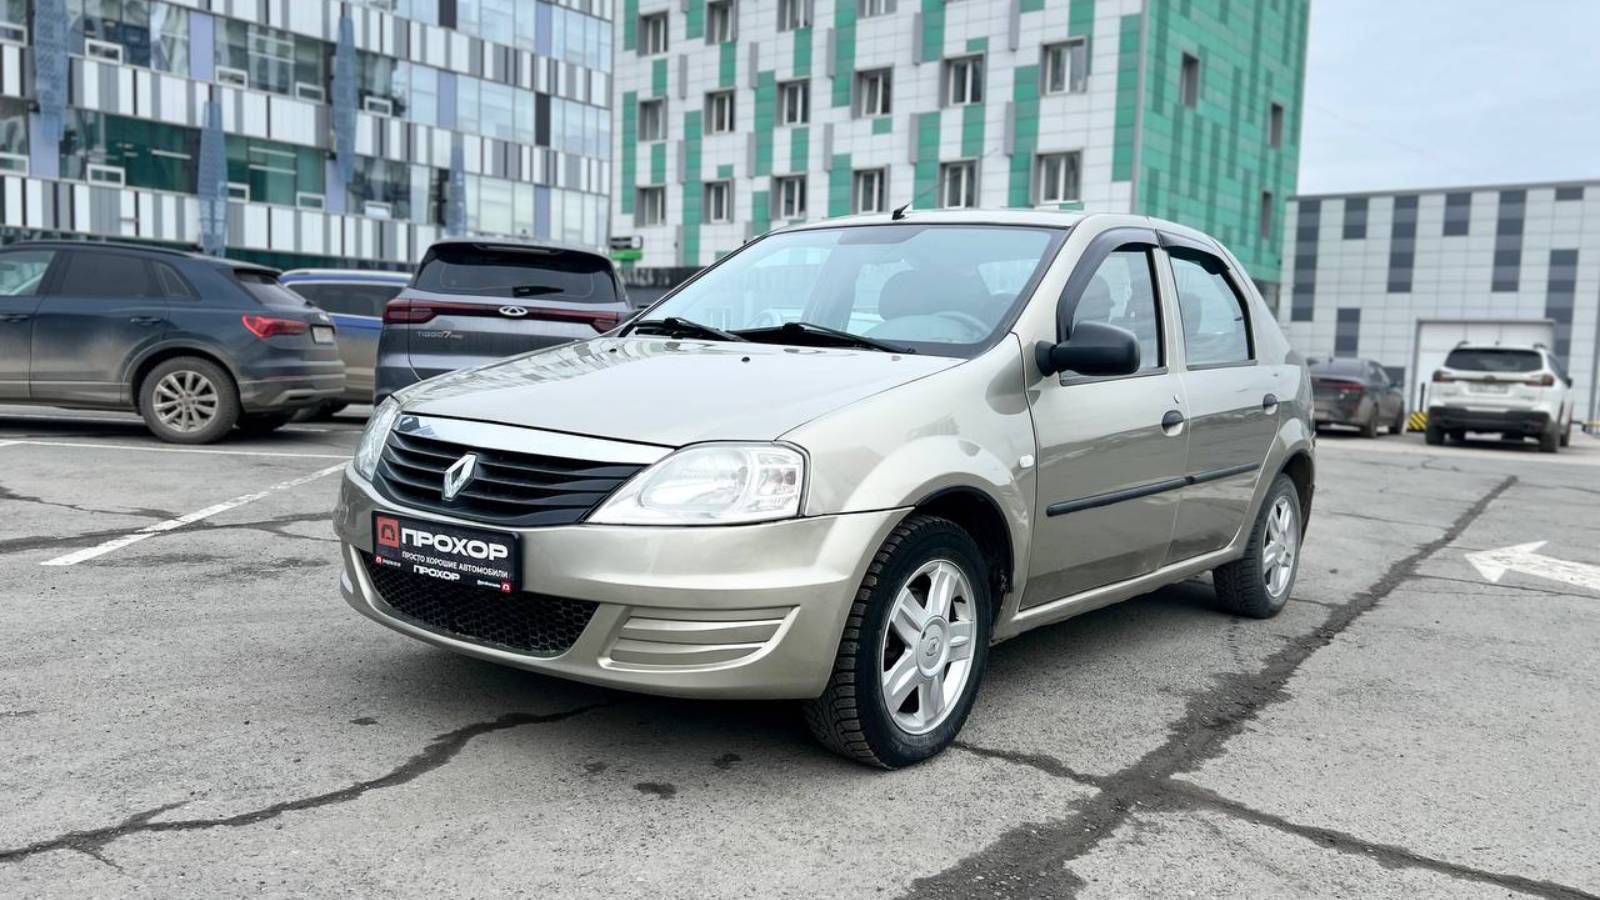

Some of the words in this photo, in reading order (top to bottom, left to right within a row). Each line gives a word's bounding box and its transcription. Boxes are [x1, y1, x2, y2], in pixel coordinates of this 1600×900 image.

[401, 528, 509, 561] ПРОХОР
[402, 551, 426, 563] ПРОСТО
[426, 556, 457, 570] ХОРОШИЕ
[458, 563, 509, 579] АВТОМОБИЛИ
[413, 564, 461, 581] ПРОХОР
